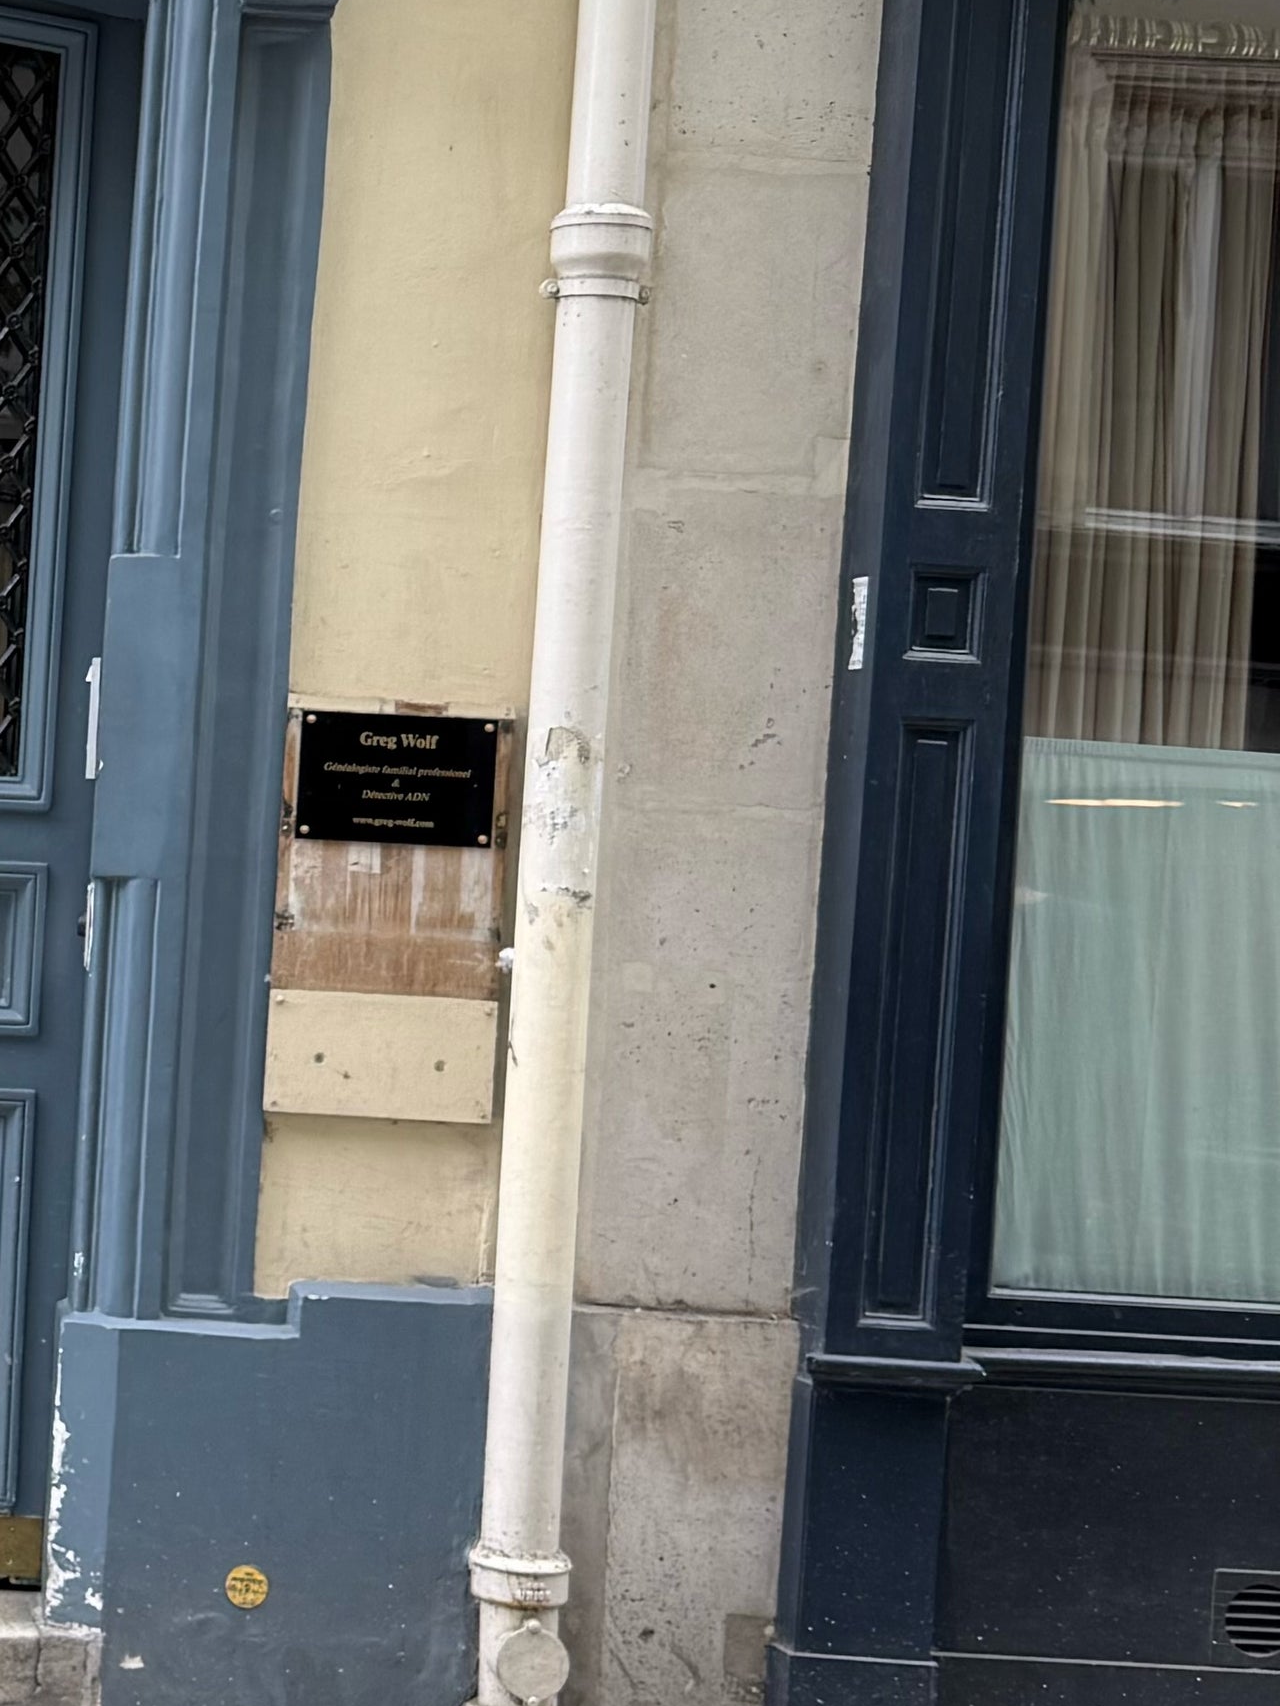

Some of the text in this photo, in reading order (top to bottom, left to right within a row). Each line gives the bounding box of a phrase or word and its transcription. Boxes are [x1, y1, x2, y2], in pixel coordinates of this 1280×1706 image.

[359, 731, 439, 750] Greg Wolf
[323, 761, 380, 775] Généalogiste
[381, 765, 417, 776] familial
[361, 789, 431, 802] Détective ADN
